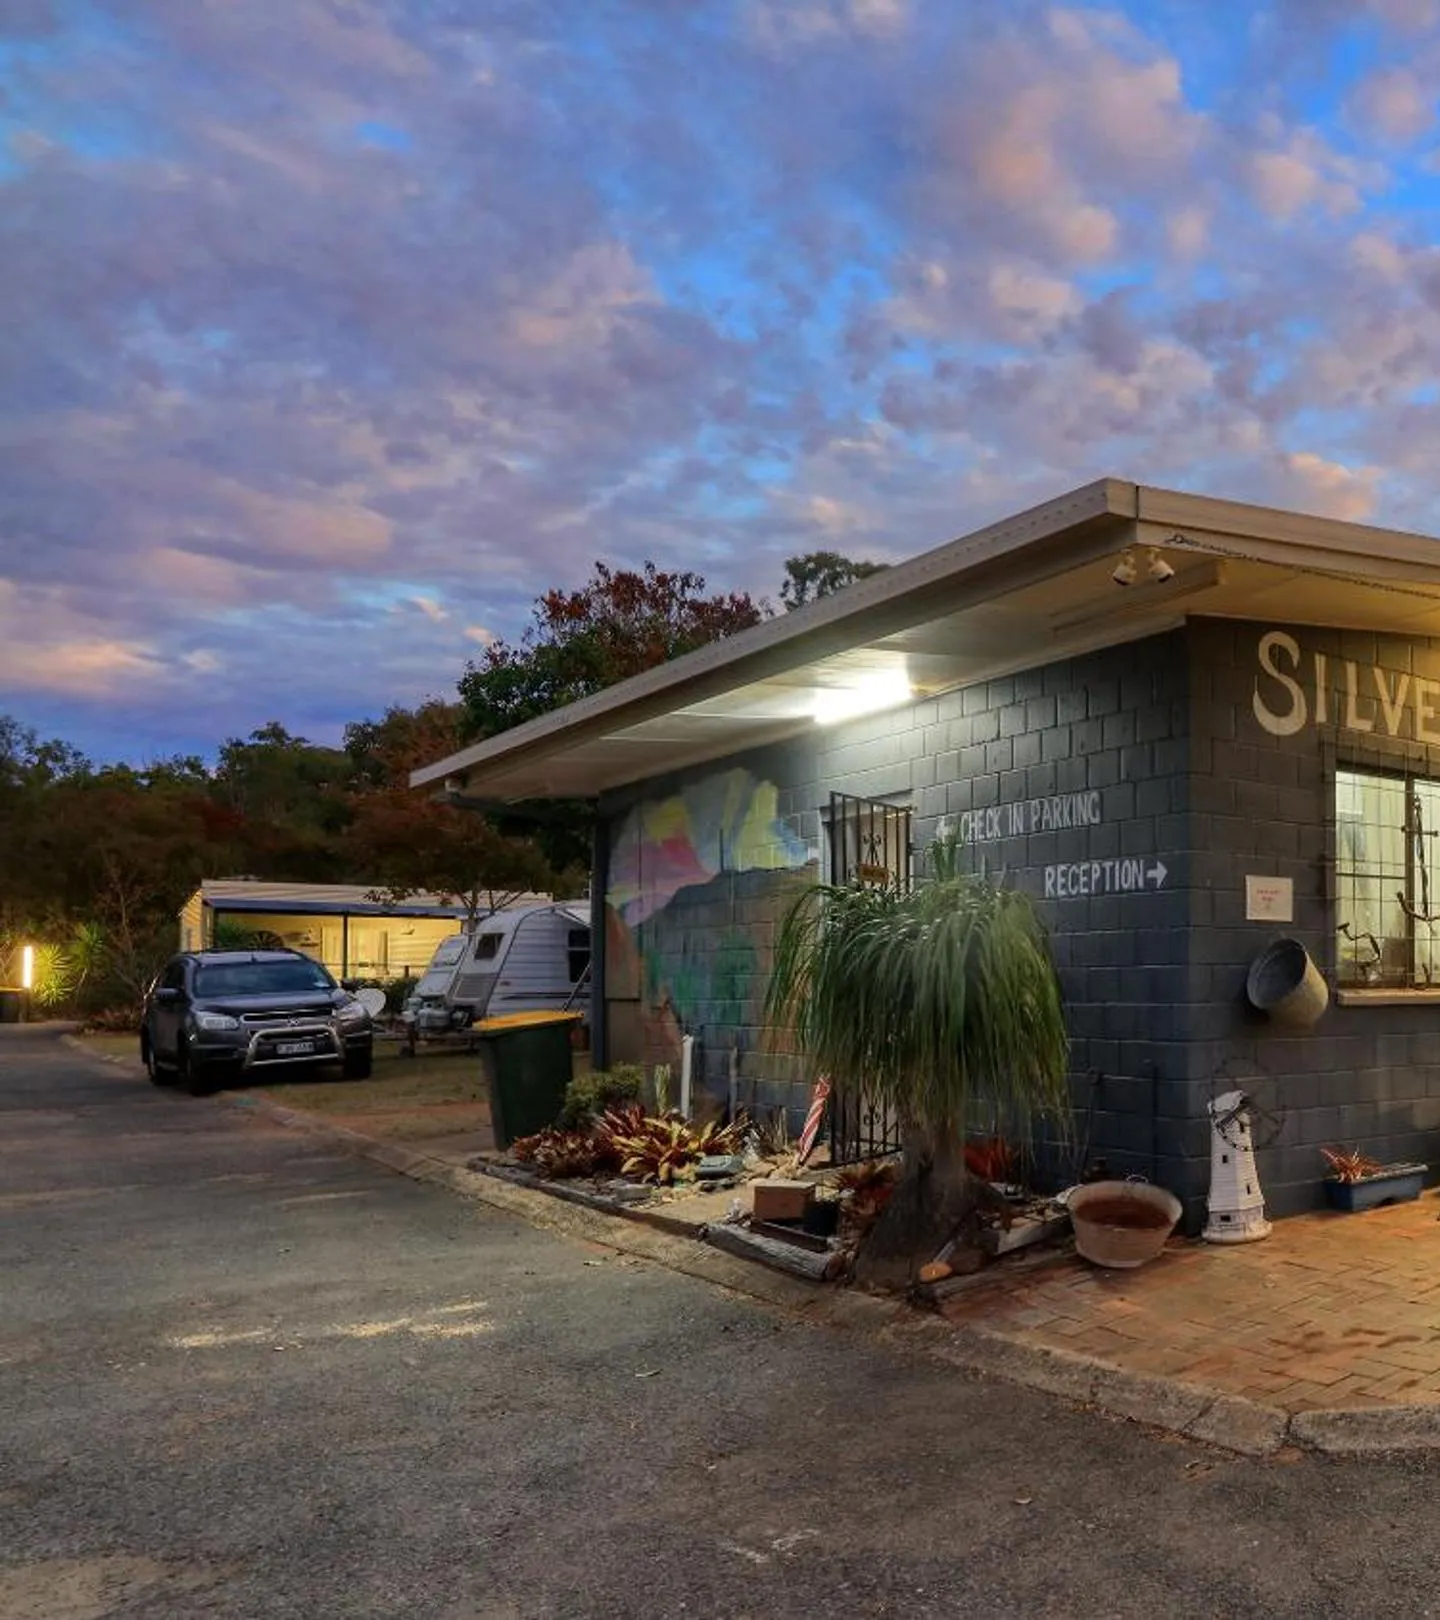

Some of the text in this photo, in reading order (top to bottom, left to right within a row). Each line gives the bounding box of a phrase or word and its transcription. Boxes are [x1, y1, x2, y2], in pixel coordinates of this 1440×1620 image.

[960, 791, 1101, 842] CHECK IN PARKING
[1045, 859, 1146, 897] RECEPTION
